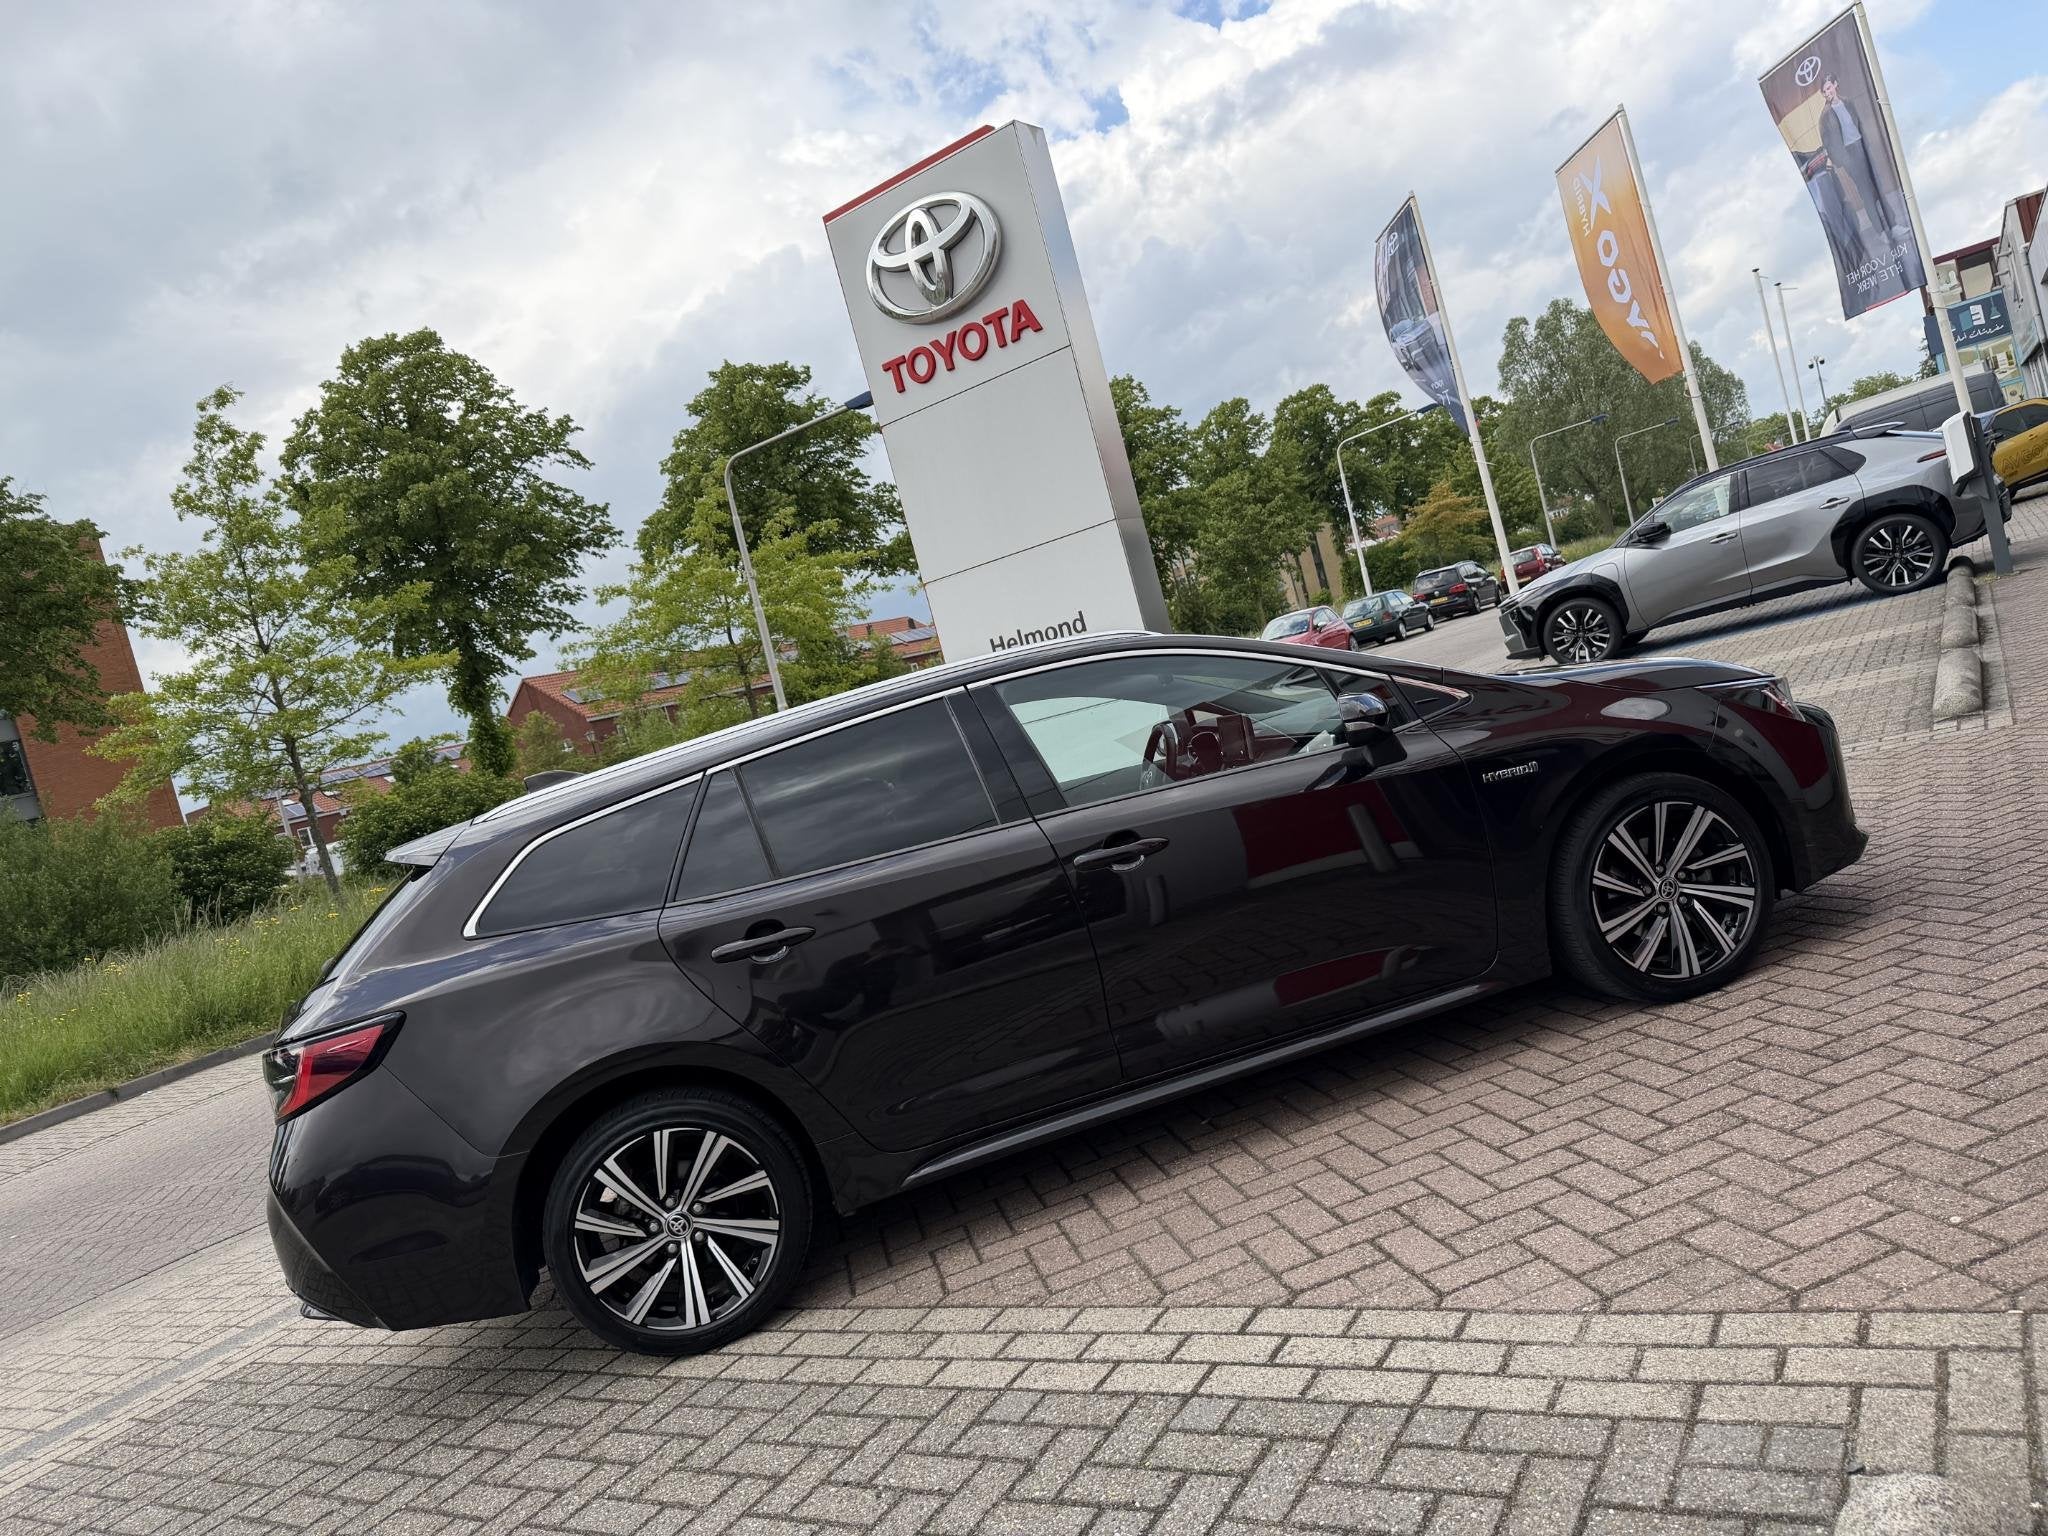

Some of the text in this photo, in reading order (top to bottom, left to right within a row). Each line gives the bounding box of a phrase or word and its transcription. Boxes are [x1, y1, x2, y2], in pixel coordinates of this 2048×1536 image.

[881, 299, 1043, 393] TOYOTA
[989, 610, 1087, 652] Helmond
[1482, 764, 1529, 783] HYBRID
